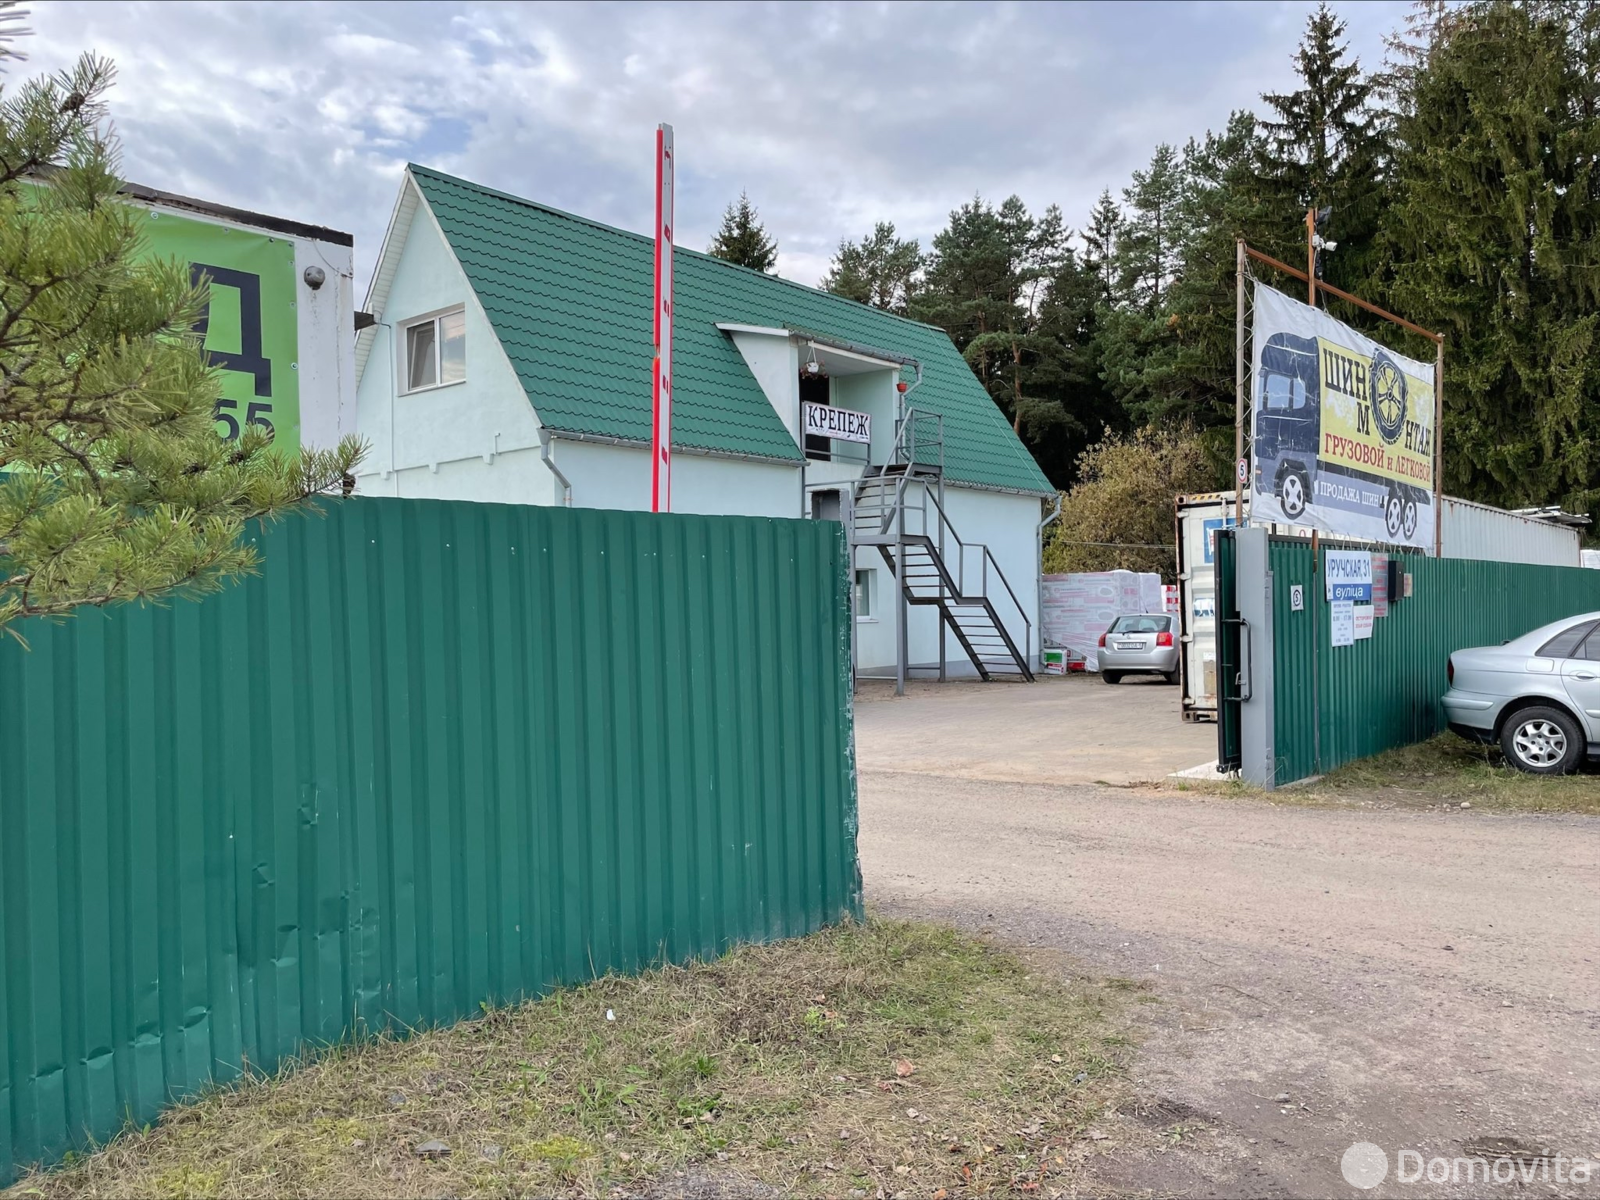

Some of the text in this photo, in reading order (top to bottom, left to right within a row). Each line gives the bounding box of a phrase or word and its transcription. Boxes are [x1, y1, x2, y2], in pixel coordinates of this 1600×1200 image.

[808, 405, 869, 436] КРЕПЕЖ
[1324, 432, 1385, 469] ГРУЗОВОЙ
[1395, 454, 1431, 483] ЛЕГКОВОЙ
[1320, 481, 1360, 504] ПРОДАЖА
[1335, 584, 1364, 600] вуліца
